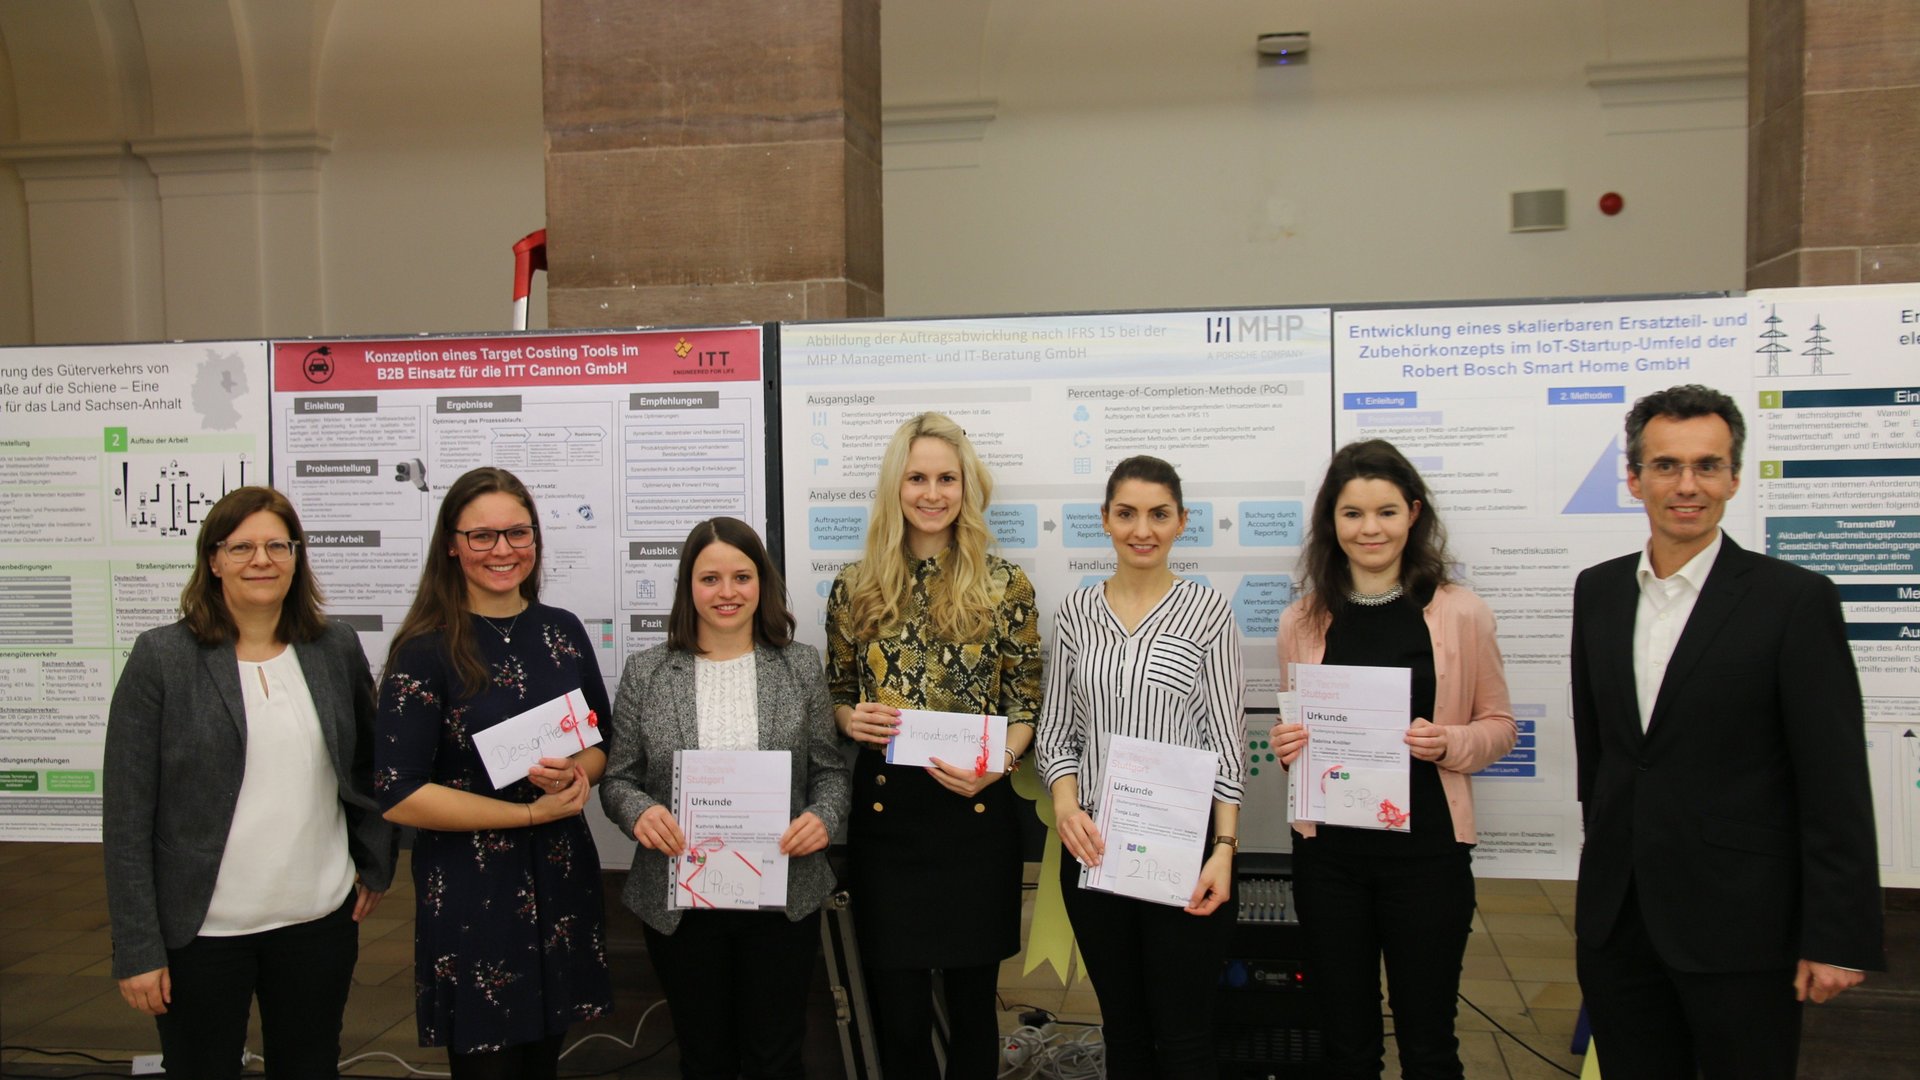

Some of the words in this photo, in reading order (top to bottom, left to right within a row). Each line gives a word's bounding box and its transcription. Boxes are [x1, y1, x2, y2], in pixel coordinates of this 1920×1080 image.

[1239, 315, 1303, 342] MHP
[1350, 325, 1451, 338] Entwicklung
[1457, 322, 1501, 335] eines
[1507, 320, 1613, 334] skalierbaren
[1620, 315, 1707, 330] Ersatzteil-
[1714, 313, 1747, 327] und
[807, 334, 871, 347] Abbildung
[875, 334, 894, 344] der
[899, 330, 1028, 345] Auftragsabwicklung
[1032, 330, 1063, 340] nach
[1068, 328, 1095, 338] IFRS
[1099, 327, 1115, 338] 15
[1120, 326, 1139, 337] bei
[1144, 325, 1166, 336] der
[1359, 343, 1505, 359] Zubehörkonzepts
[1512, 341, 1531, 353] im
[1537, 336, 1701, 354] IoT-Startup-Umfeld
[1707, 336, 1736, 348] der
[365, 350, 438, 364] Konzeption
[442, 349, 477, 361] eines
[480, 347, 523, 362] Target
[525, 346, 577, 360] Costing
[581, 344, 618, 357] Tools
[622, 344, 638, 356] im
[698, 351, 730, 366] ITT
[807, 354, 837, 366] MHP
[842, 353, 931, 366] Management-
[936, 350, 960, 362] und
[964, 349, 1041, 362] IT-Beratung
[1045, 347, 1086, 360] GmbH
[32, 365, 54, 376] des
[57, 363, 143, 376] Güterverkehrs
[148, 364, 169, 374] von
[377, 368, 404, 380] B2B
[408, 366, 456, 379] Einsatz
[459, 365, 478, 377] für
[481, 365, 501, 377] die
[505, 364, 525, 377] ITT
[530, 364, 581, 376] Cannon
[585, 362, 627, 375] GmbH
[1402, 364, 1458, 377] Robert
[1464, 362, 1517, 376] Bosch
[1523, 360, 1573, 375] Smart
[1580, 360, 1629, 372] Home
[1636, 357, 1690, 371] GmbH
[23, 383, 42, 394] auf
[46, 383, 63, 393] die
[68, 382, 116, 393] Schiene
[133, 381, 159, 392] Eine
[1068, 385, 1257, 399] Percentage-of-Completion-Methode
[1260, 384, 1287, 395] (PoC)
[5, 402, 21, 413] für
[25, 401, 47, 412] das
[51, 400, 80, 412] Land
[85, 398, 182, 411] Sachsen-Anhalt
[640, 397, 702, 406] Empfehlungen
[808, 395, 875, 406] Ausgangslage
[1366, 398, 1404, 406] Einleitung
[1765, 395, 1773, 405] 1
[304, 402, 345, 411] Einleitung
[447, 401, 493, 411] Ergebnisse
[112, 434, 120, 446] 2
[306, 464, 371, 473] Problemstellung
[1765, 465, 1774, 476] 3
[810, 491, 846, 501] Analyse
[849, 491, 866, 499] des
[1837, 520, 1896, 528] TransnetBW
[640, 547, 678, 555] Ausblick
[1492, 547, 1568, 555] Thesendiskussion
[1811, 553, 1875, 562] Anforderungen
[1838, 563, 1913, 572] Vergabeplattform
[641, 620, 662, 628] Fazit
[1307, 712, 1348, 722] Urkunde
[1114, 782, 1153, 796] Urkunde
[691, 798, 732, 806] Urkunde
[1127, 859, 1145, 878] 2
